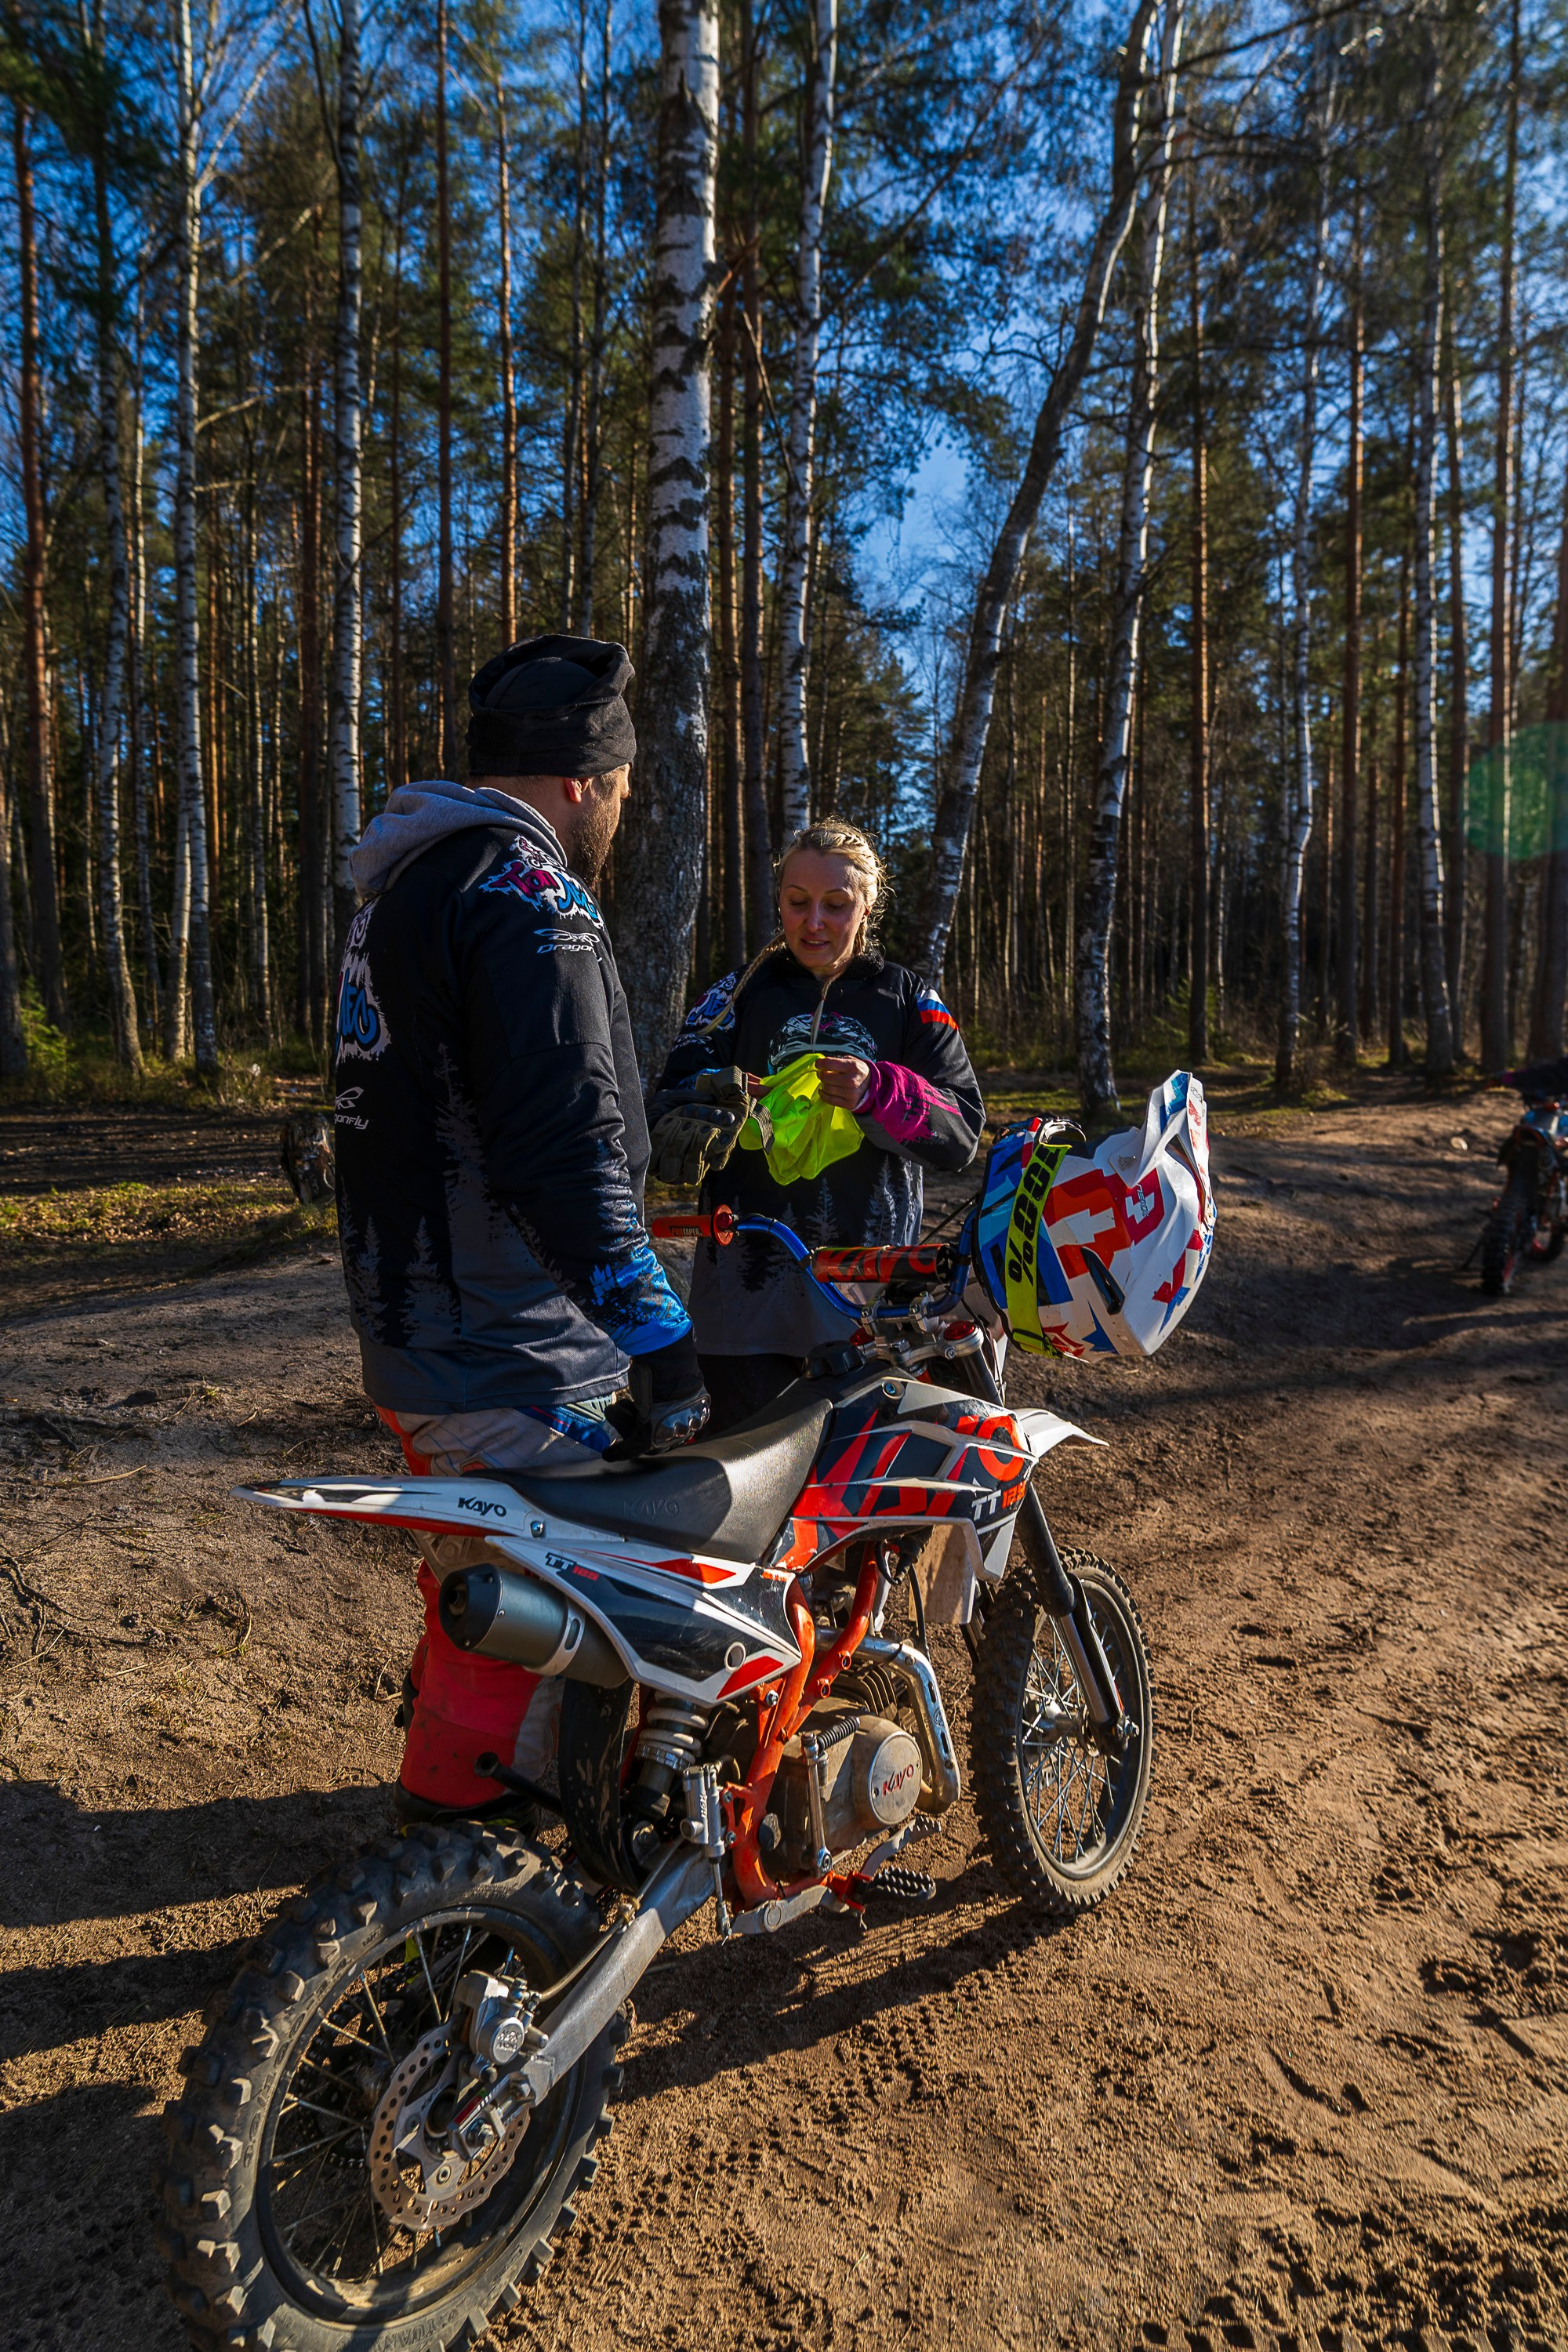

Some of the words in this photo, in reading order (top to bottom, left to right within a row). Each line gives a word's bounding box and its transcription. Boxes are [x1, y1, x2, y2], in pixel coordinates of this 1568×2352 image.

[457, 1496, 507, 1518] KAYO
[971, 1489, 1002, 1522] TT
[547, 1553, 575, 1570] TT
[572, 1565, 600, 1581] 125
[882, 1764, 914, 1798] KAYO
